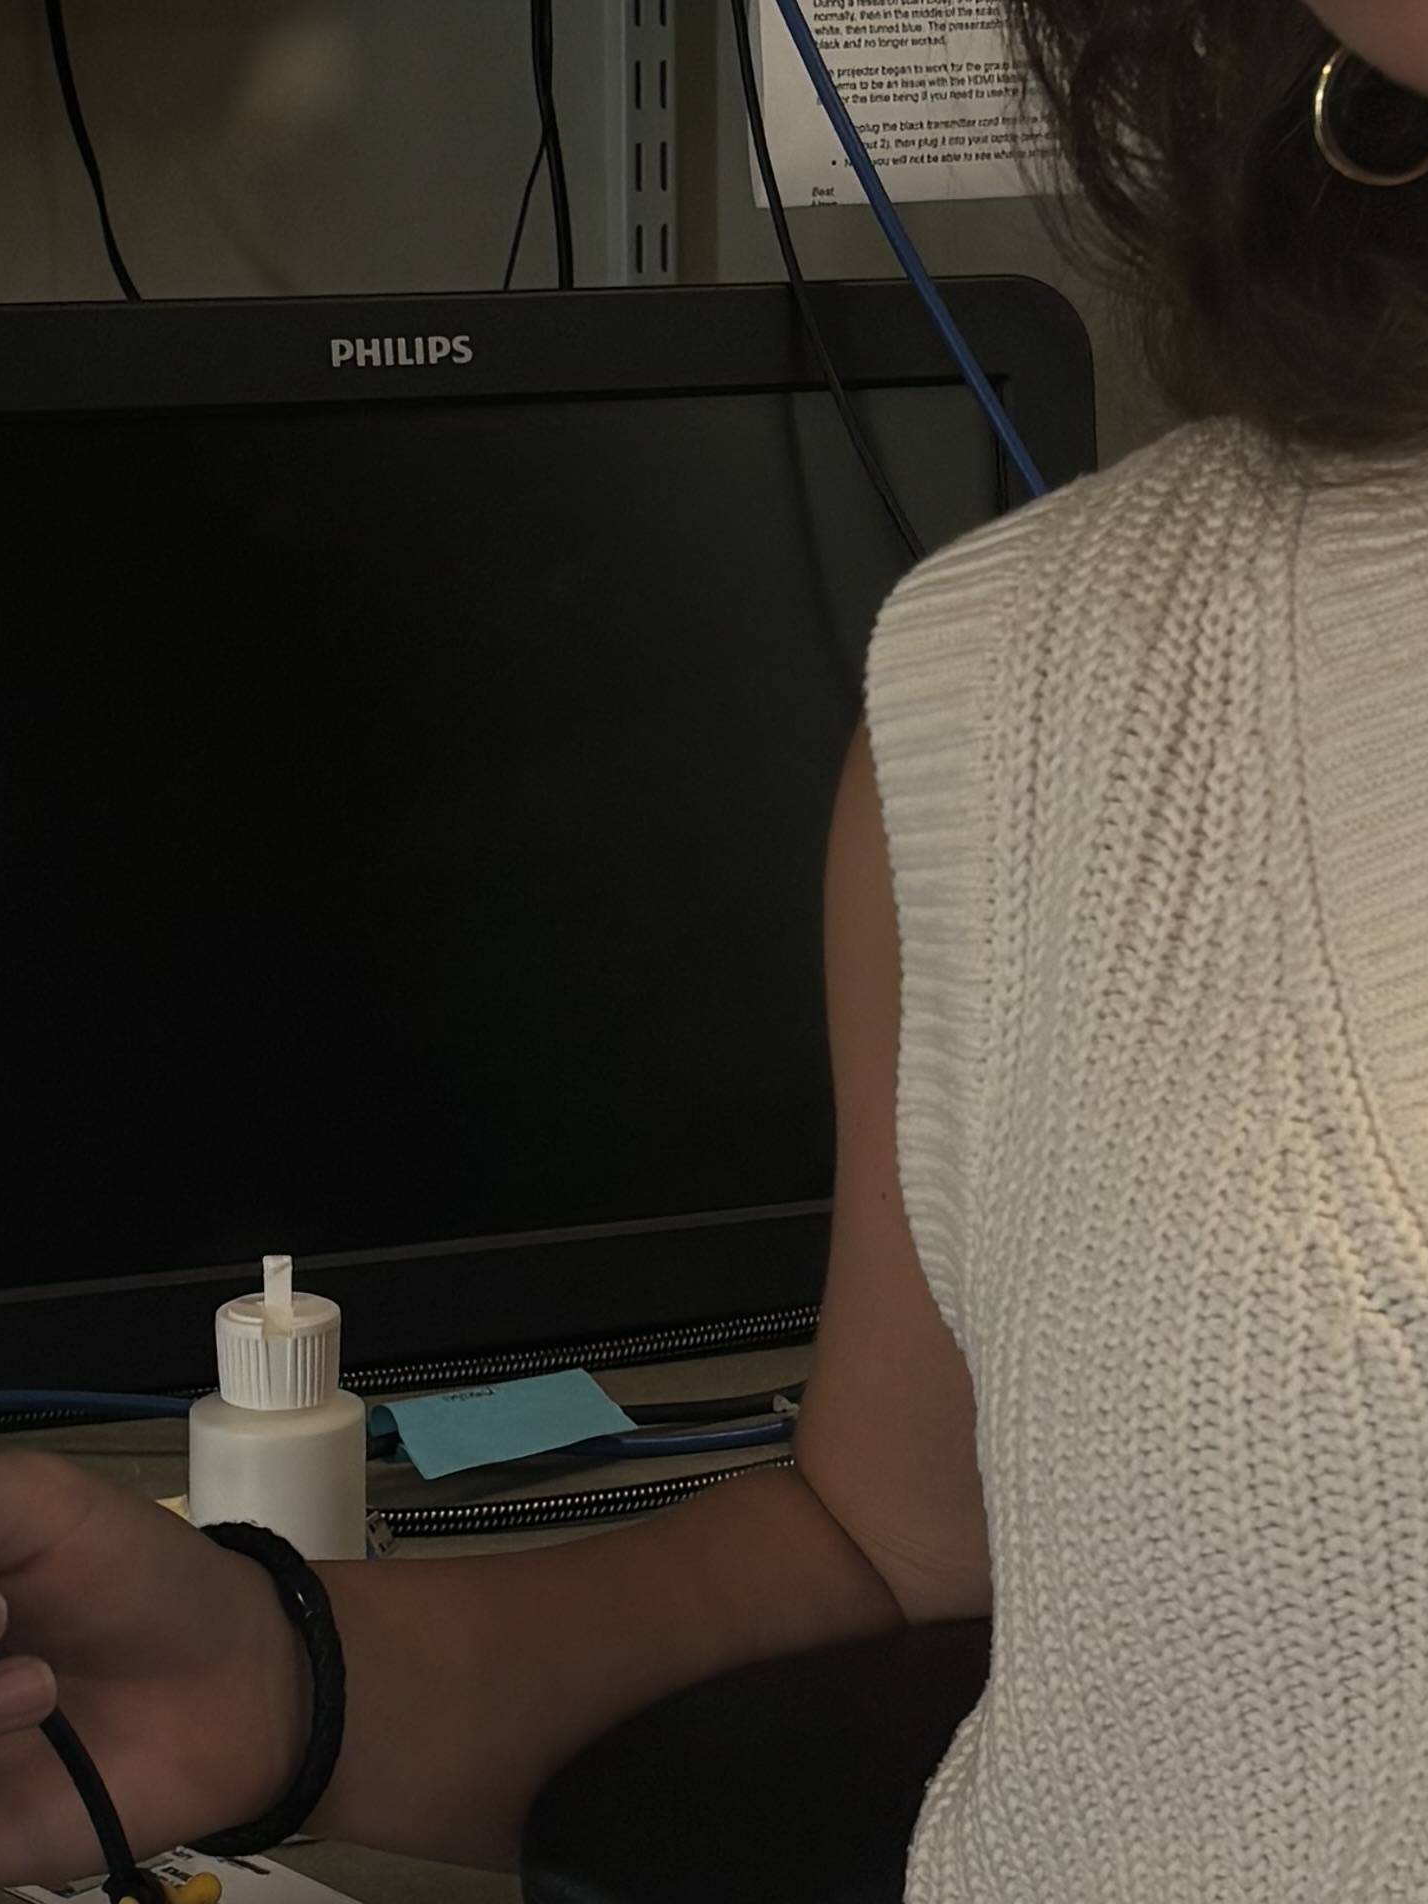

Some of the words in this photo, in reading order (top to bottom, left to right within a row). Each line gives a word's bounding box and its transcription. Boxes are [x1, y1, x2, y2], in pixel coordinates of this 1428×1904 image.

[878, 36, 909, 49] longer
[837, 65, 879, 78] projector
[331, 335, 473, 367] PHILIPS
